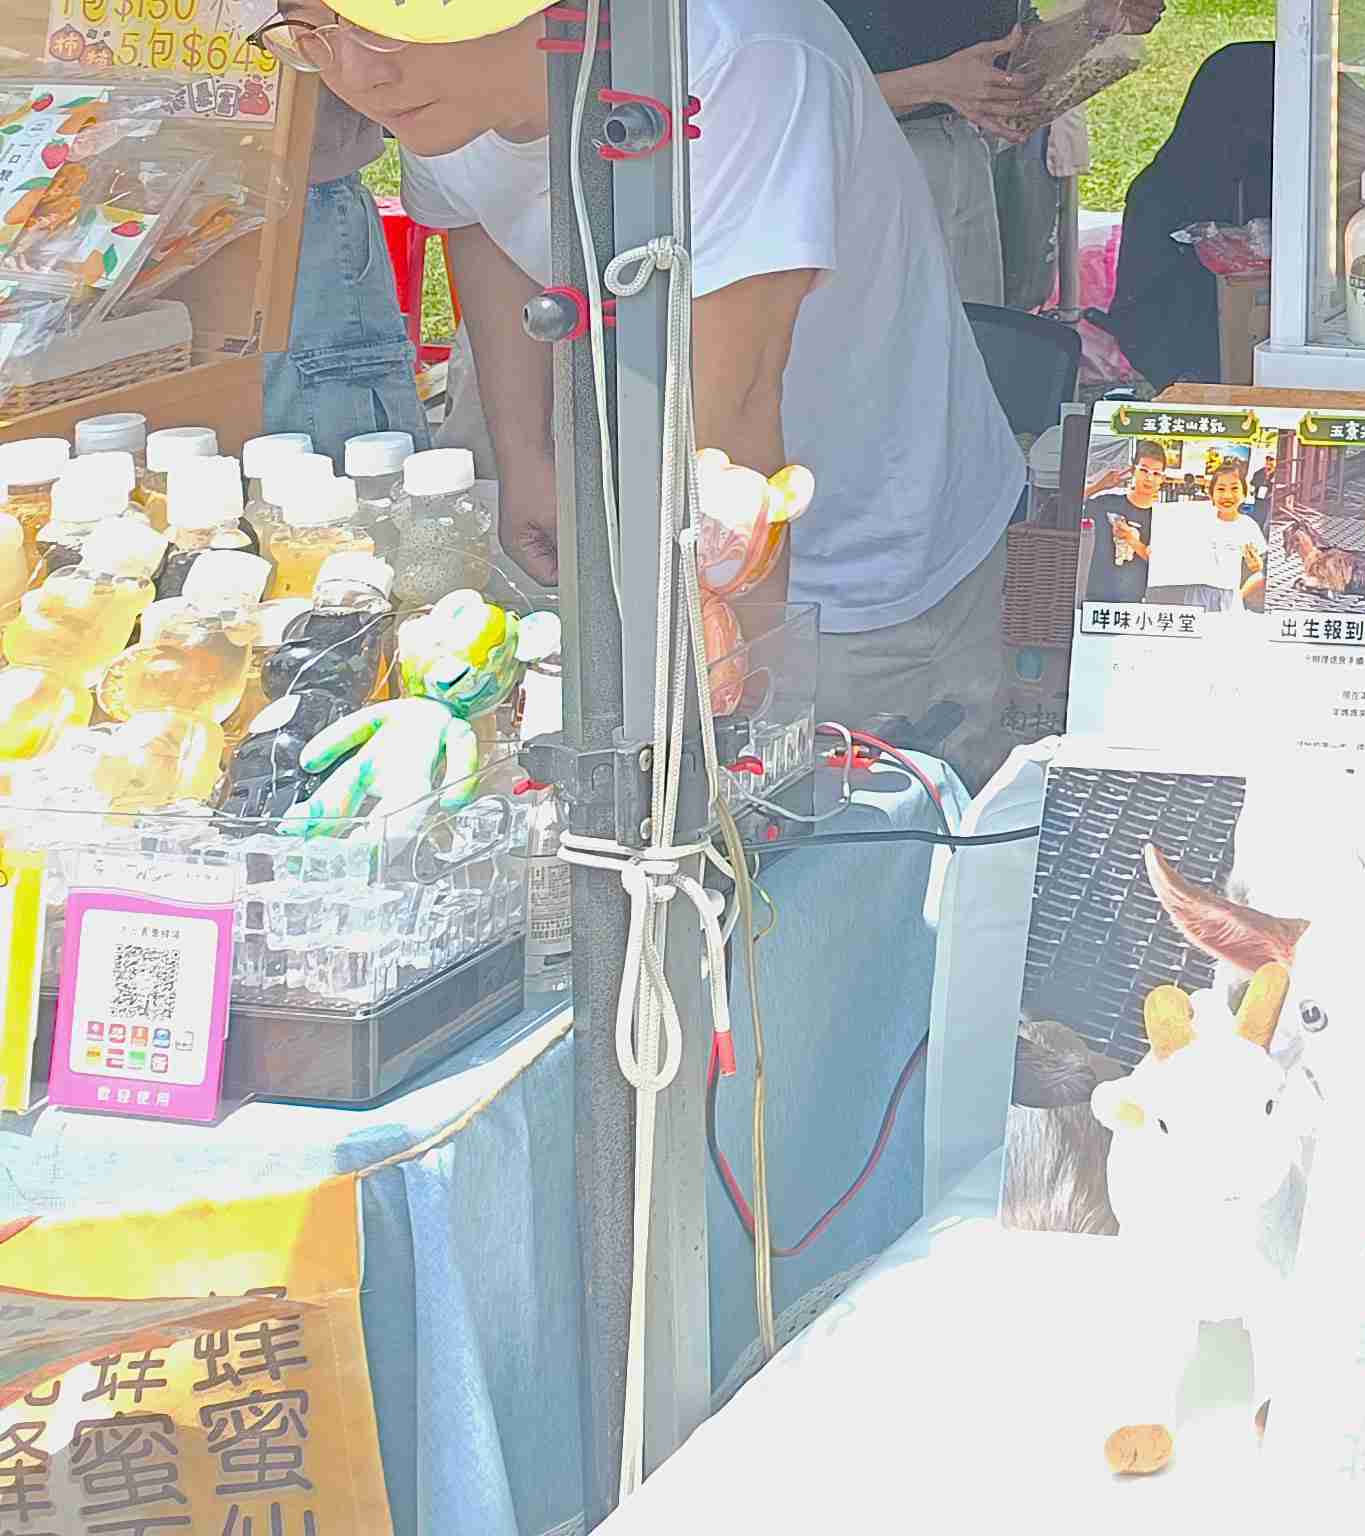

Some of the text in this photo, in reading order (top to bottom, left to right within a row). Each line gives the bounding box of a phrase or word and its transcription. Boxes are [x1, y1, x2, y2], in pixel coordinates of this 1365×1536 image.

[1091, 608, 1197, 635] 咩味小學堂
